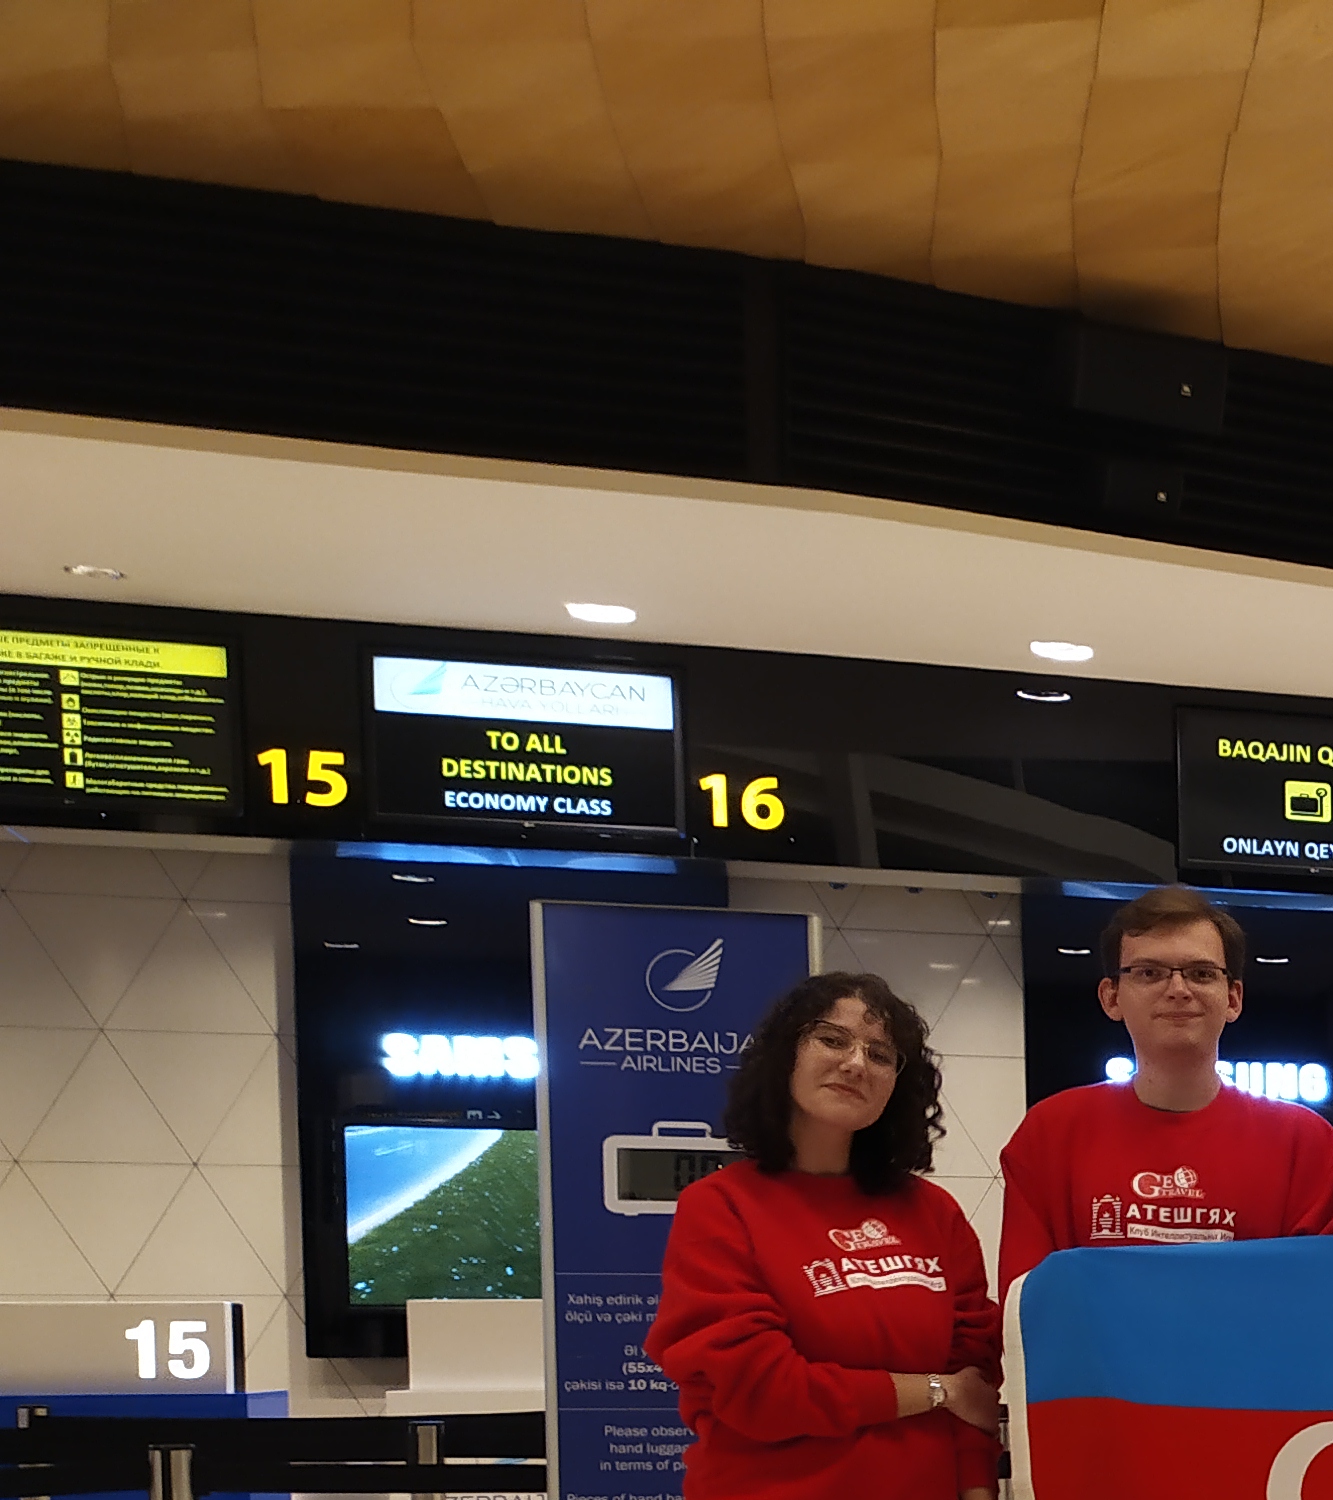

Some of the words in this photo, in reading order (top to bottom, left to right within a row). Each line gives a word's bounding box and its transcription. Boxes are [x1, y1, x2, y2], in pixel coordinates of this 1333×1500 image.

[80, 655, 122, 666] РУЧНОЙ
[461, 673, 646, 702] AZƏRBAYCAN
[486, 730, 519, 751] TO
[525, 734, 567, 755] ALL
[1218, 738, 1311, 763] BAQAJIN
[257, 748, 348, 807] 15
[441, 757, 613, 787] DESTINATIONS
[444, 790, 548, 813] ECONOMY
[553, 797, 612, 816] CLASS
[699, 773, 785, 831] 16
[1222, 837, 1299, 857] ONLAYN
[620, 1055, 722, 1074] AIRLINES
[1126, 1203, 1237, 1227] АТЕШГЯХ
[1129, 1226, 1149, 1237] Клуб
[840, 1255, 943, 1274] АТЕШГЯХ
[567, 1293, 603, 1307] Xahiş
[606, 1294, 643, 1306] edirik
[565, 1310, 592, 1324] ölçü
[596, 1313, 612, 1322] və
[615, 1312, 642, 1324] çəki
[125, 1320, 210, 1379] 15
[564, 1380, 602, 1392] çəkisi
[605, 1380, 625, 1391] isə
[628, 1379, 647, 1391] 10
[604, 1425, 648, 1437] Please
[609, 1443, 643, 1454] hand
[599, 1460, 612, 1471] in
[615, 1461, 653, 1471] terms
[656, 1459, 670, 1471] of
